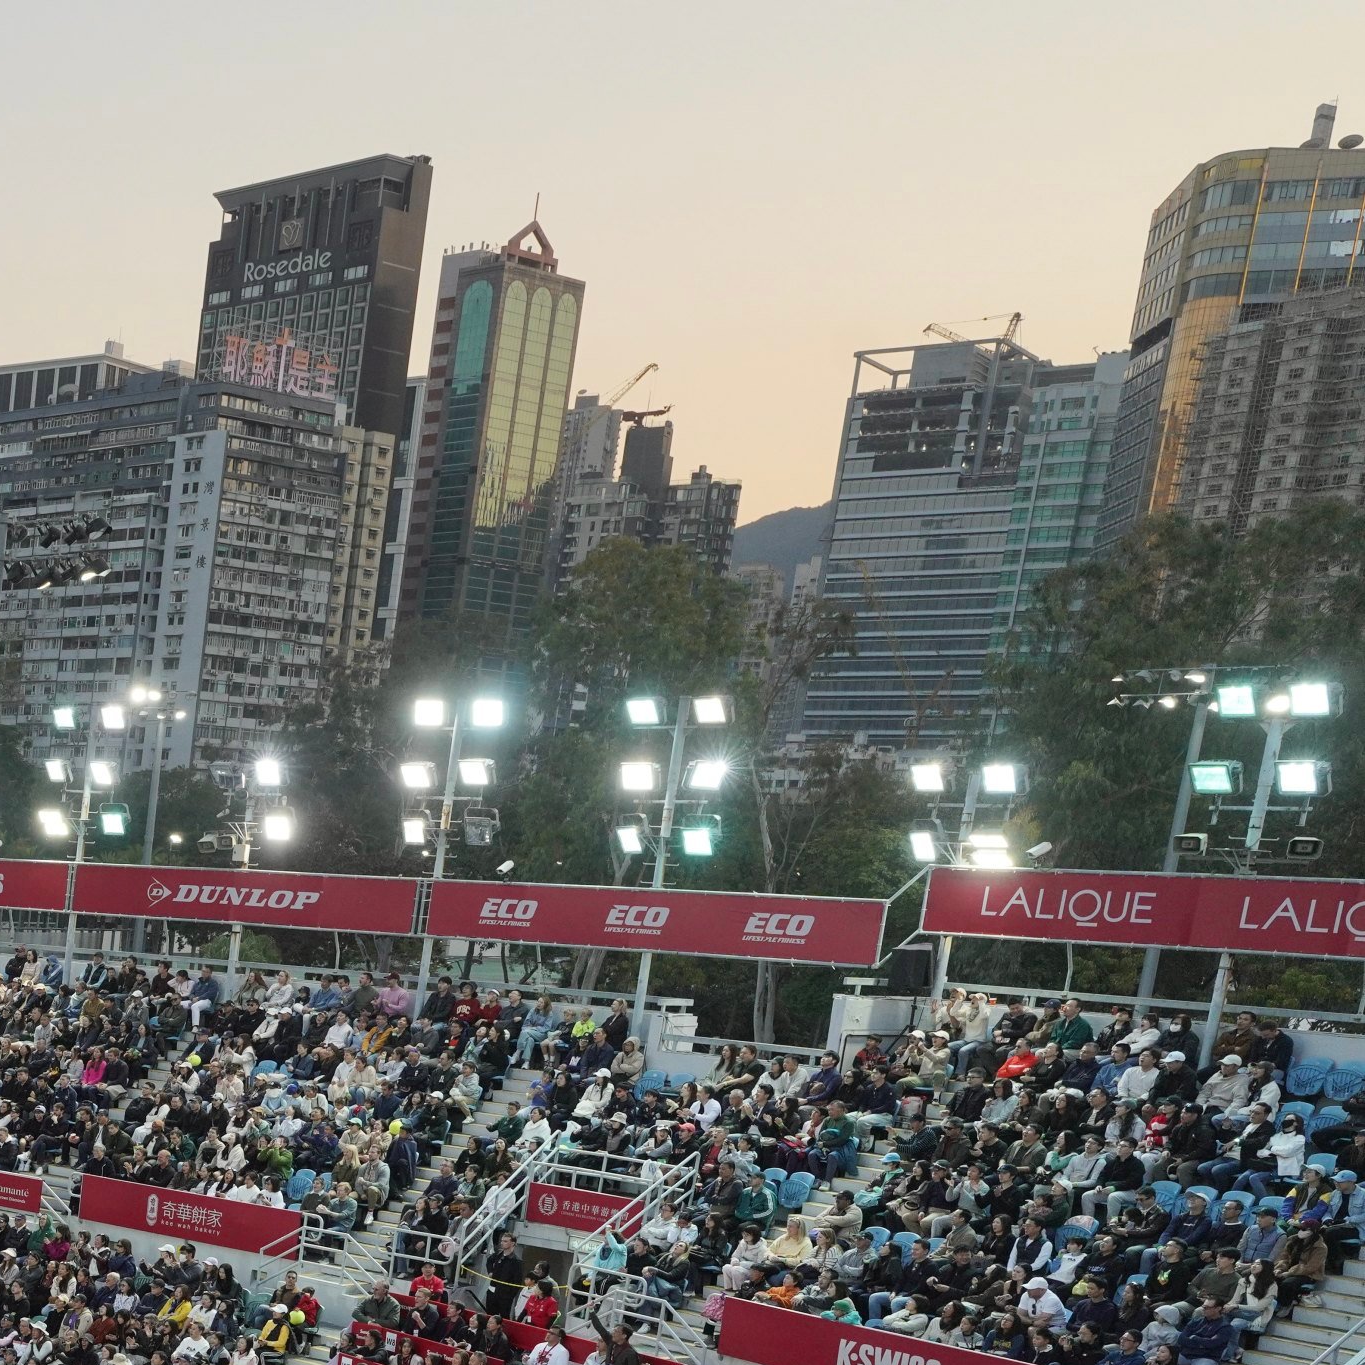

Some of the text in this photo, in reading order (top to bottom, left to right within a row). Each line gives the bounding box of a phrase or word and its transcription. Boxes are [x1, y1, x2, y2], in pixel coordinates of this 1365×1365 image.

[244, 248, 332, 282] Rosedale
[172, 884, 321, 911] DUNLOP
[480, 898, 538, 920] ECO
[980, 885, 1157, 928] LALIQUE
[605, 905, 670, 928] ECO
[744, 912, 815, 936] ECO
[162, 1200, 222, 1228] 奇華餅家
